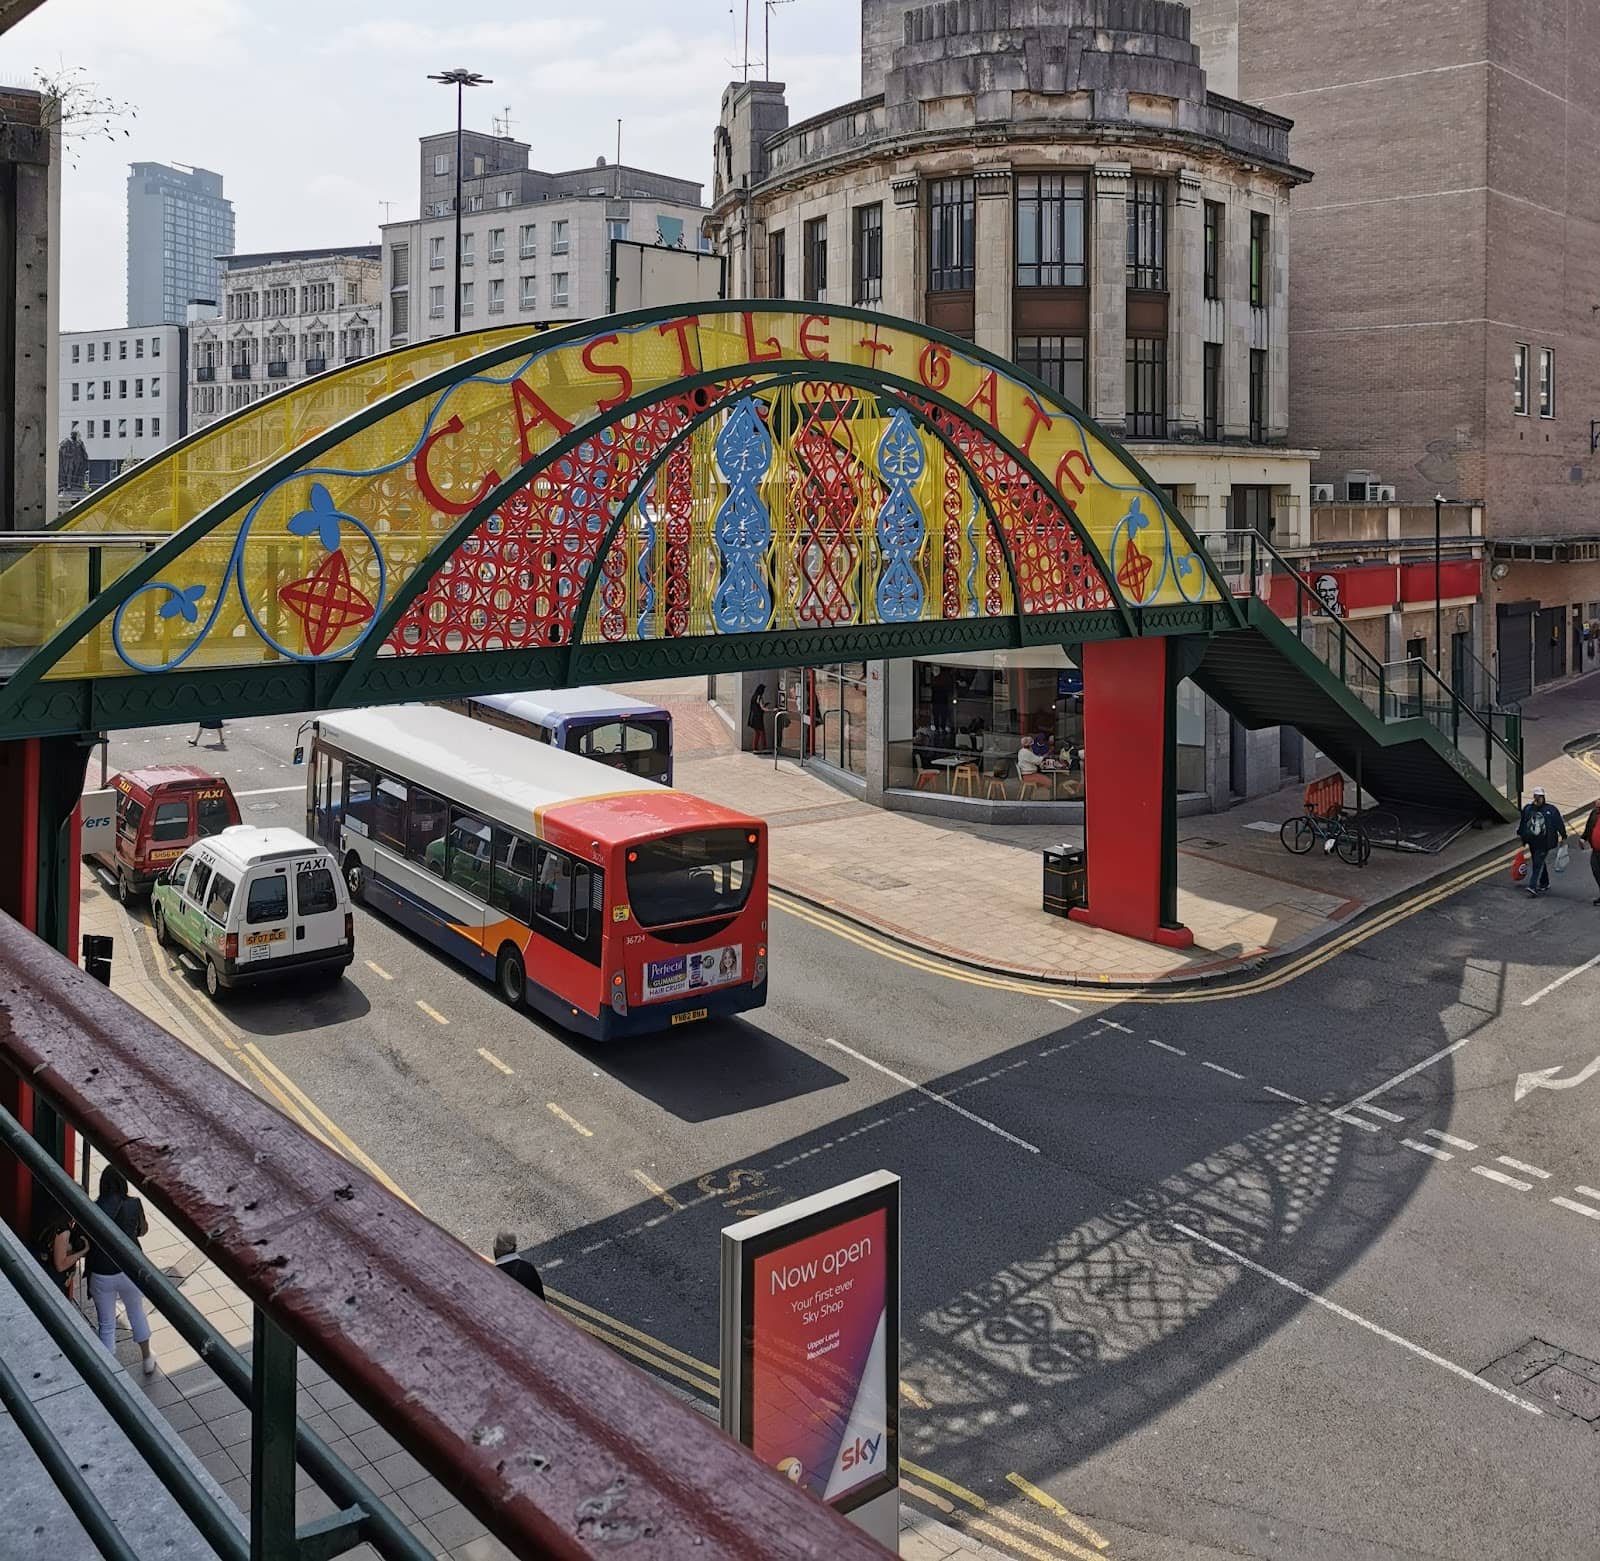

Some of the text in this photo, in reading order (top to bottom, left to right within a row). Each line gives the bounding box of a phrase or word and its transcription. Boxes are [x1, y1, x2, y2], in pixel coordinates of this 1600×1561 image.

[119, 780, 132, 793] TAXI
[197, 790, 224, 799] TAXI
[200, 851, 216, 864] TAXI
[296, 858, 327, 872] TAXI
[653, 974, 682, 987] GUMMIES
[649, 982, 685, 996] HAIR CRUSH
[770, 1237, 871, 1295] Now open
[791, 1279, 854, 1313] Your first ever
[802, 1299, 844, 1326] Sky Shop
[807, 1329, 840, 1350] Upper Level
[841, 1432, 882, 1471] sky
